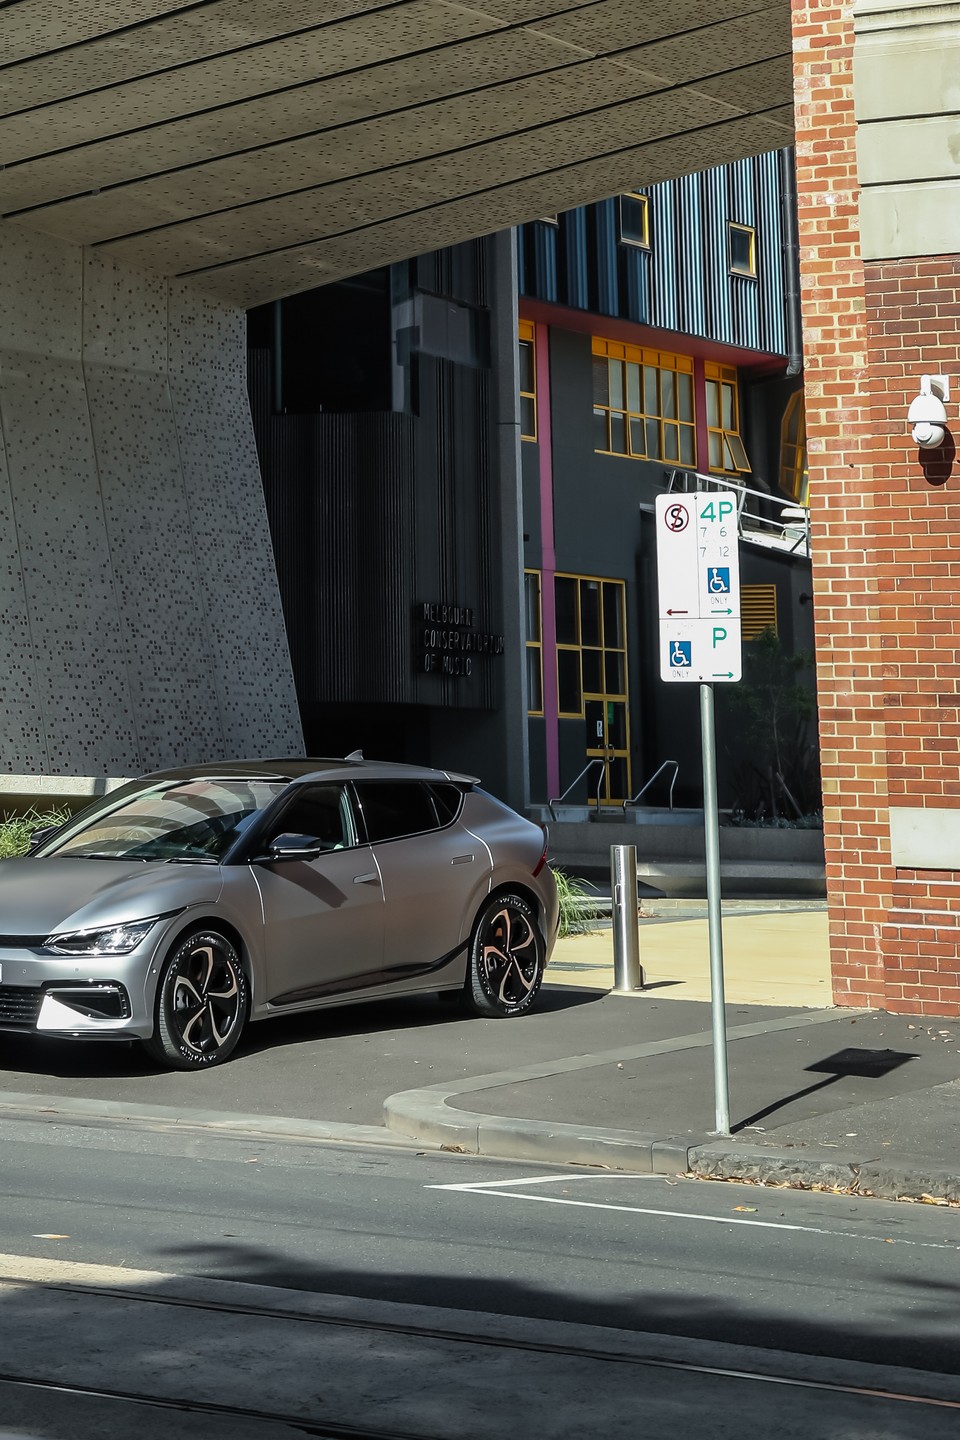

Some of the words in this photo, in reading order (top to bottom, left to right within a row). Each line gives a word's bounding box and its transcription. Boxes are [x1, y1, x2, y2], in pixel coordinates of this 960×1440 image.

[700, 501, 733, 523] 4P
[700, 527, 707, 538] 7
[719, 526, 727, 537] 6
[699, 546, 707, 558] 7
[719, 545, 730, 557] 12
[710, 596, 728, 605] ONLY
[424, 603, 476, 626] MELBOURNE
[713, 627, 727, 648] P
[424, 653, 436, 672] OF
[442, 655, 472, 676] MUSIC
[672, 669, 690, 679] ONLY
